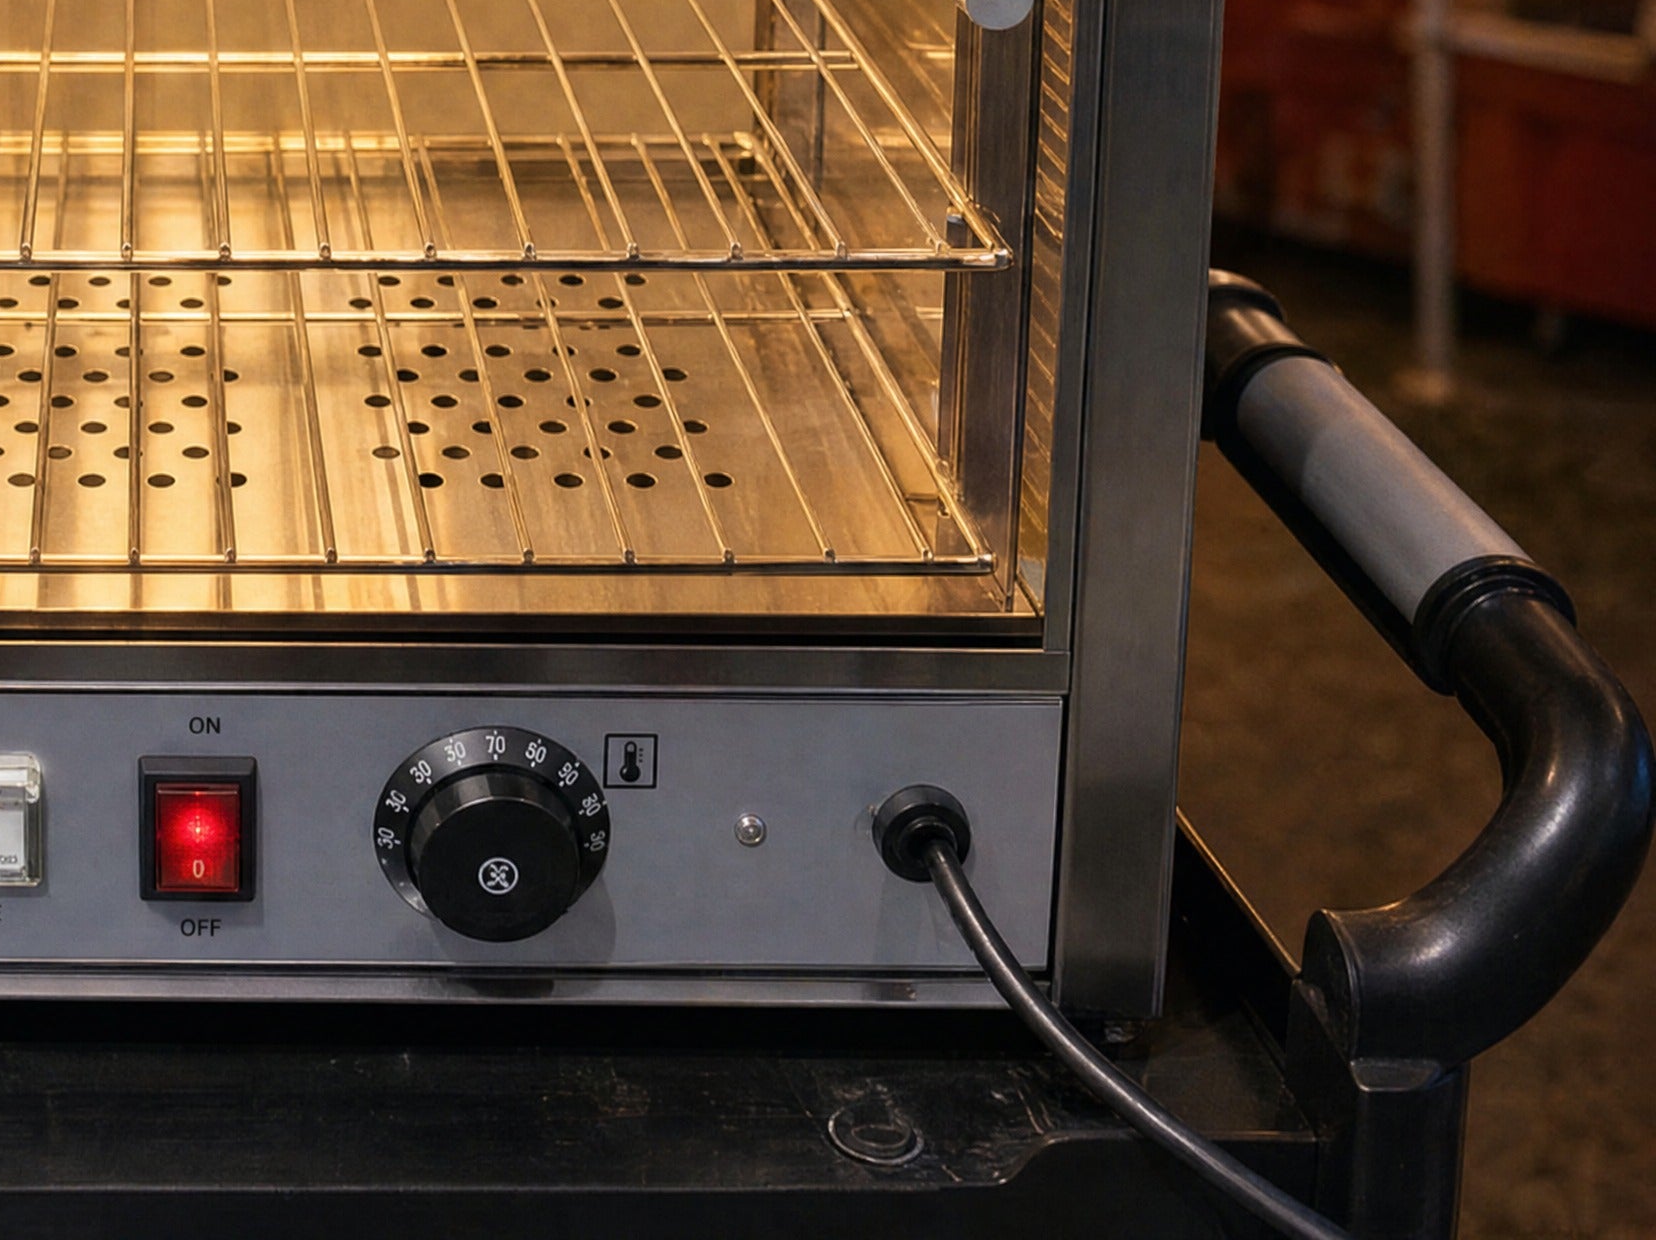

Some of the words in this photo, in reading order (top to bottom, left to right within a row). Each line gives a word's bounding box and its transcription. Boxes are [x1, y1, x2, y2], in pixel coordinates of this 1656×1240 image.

[188, 716, 221, 735] ON
[409, 759, 432, 784] 30
[485, 735, 506, 754] 70
[180, 918, 222, 937] OFF
